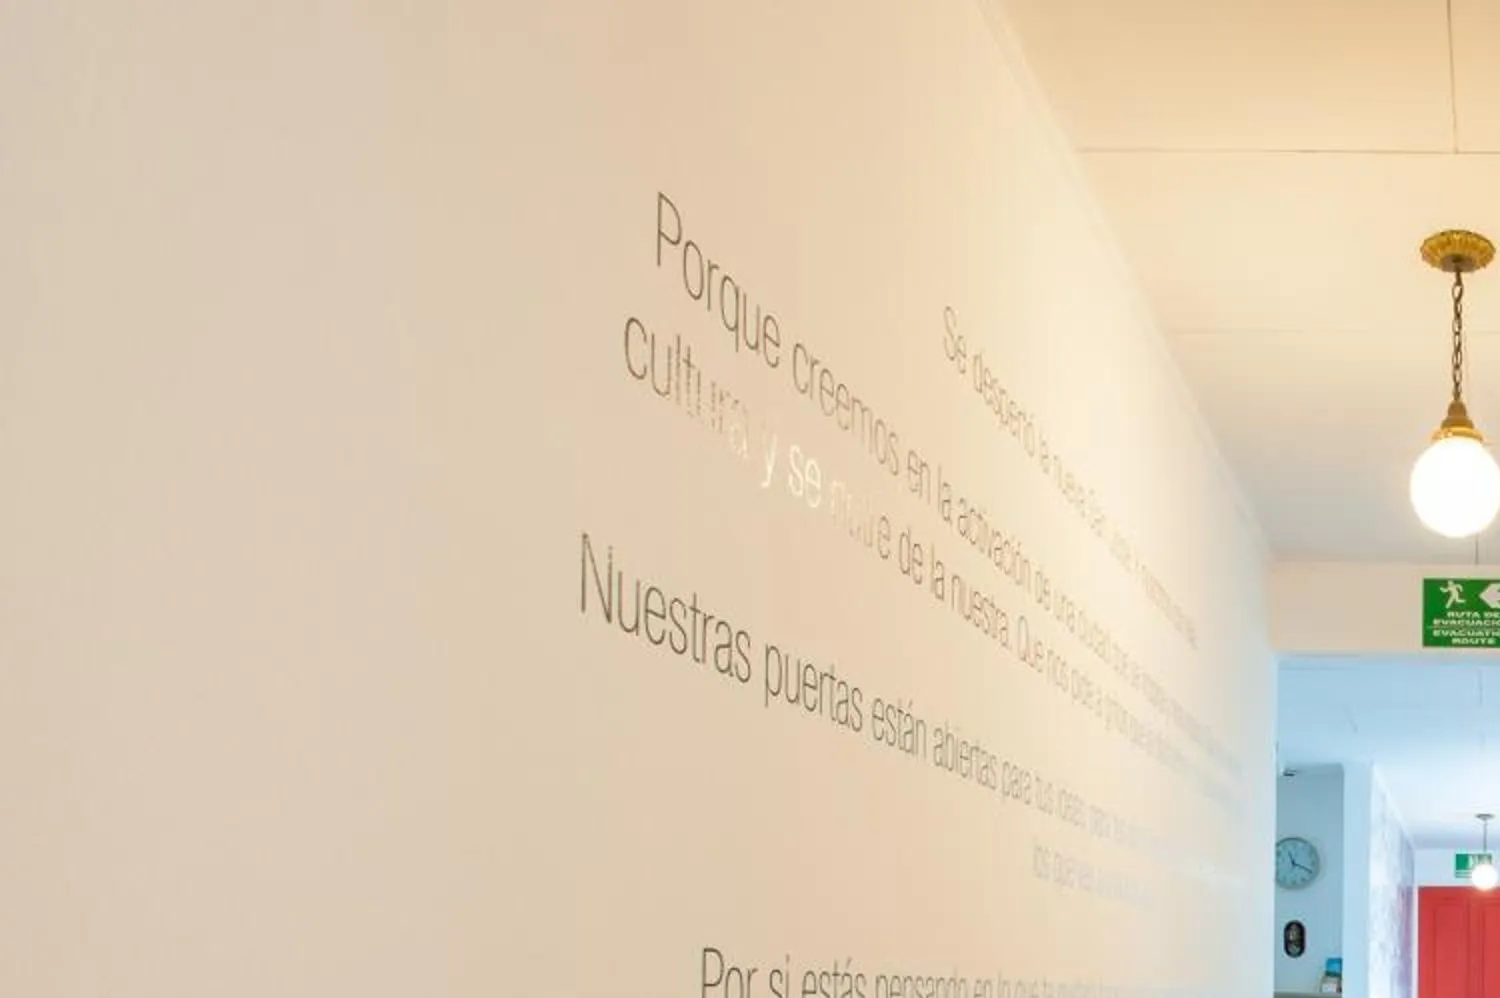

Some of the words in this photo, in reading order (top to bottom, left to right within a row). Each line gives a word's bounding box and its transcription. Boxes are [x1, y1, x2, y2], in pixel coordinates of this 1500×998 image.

[624, 317, 746, 450] cultura
[761, 435, 777, 488] y
[789, 445, 820, 508] se
[899, 529, 923, 585] de
[931, 546, 945, 602] la
[657, 192, 780, 368] Porque
[793, 343, 898, 476] creemos
[907, 450, 930, 500] en
[937, 460, 952, 525] la
[581, 533, 751, 683] Nuestras
[765, 645, 862, 732] puertas
[872, 698, 926, 754] están
[934, 728, 996, 790] abiertas
[1452, 637, 1495, 645] ROUTE
